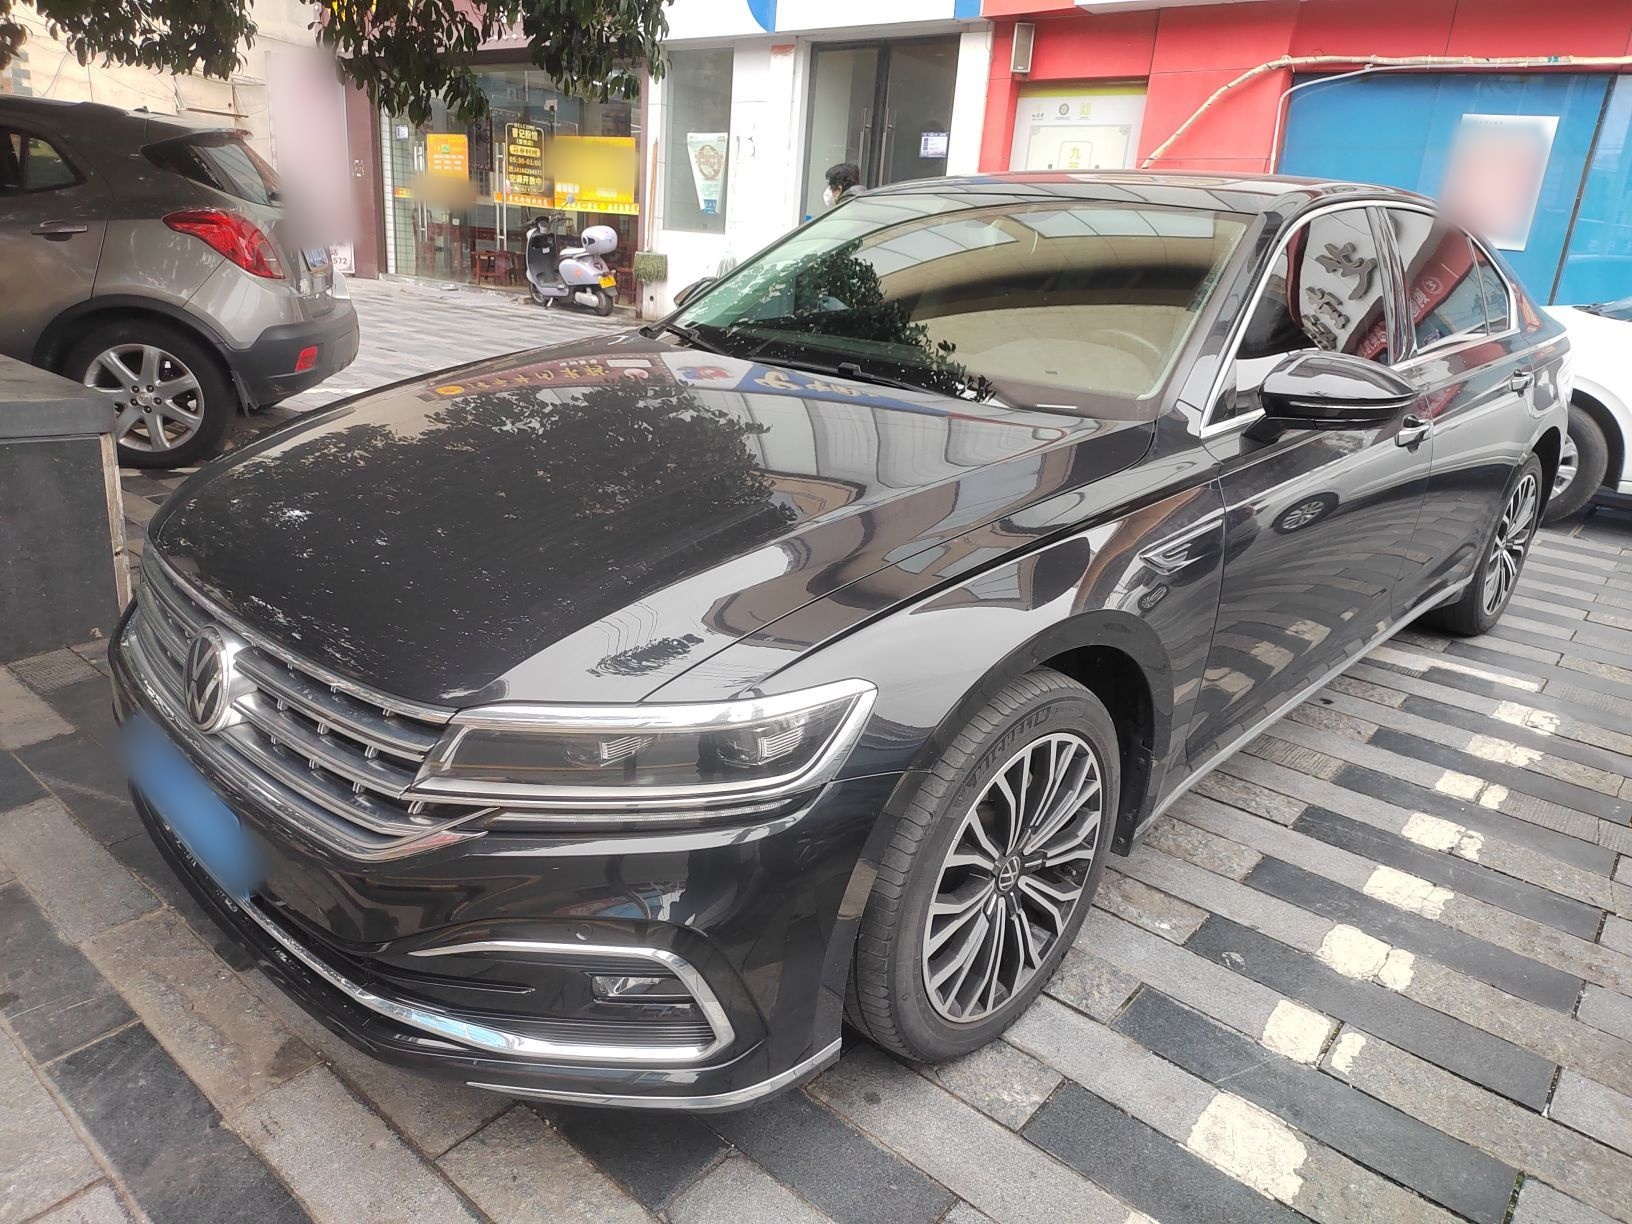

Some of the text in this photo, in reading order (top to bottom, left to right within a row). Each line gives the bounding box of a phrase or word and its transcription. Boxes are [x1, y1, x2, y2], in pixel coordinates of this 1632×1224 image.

[513, 123, 536, 131] WELCOME
[508, 174, 543, 186] 空调开放中
